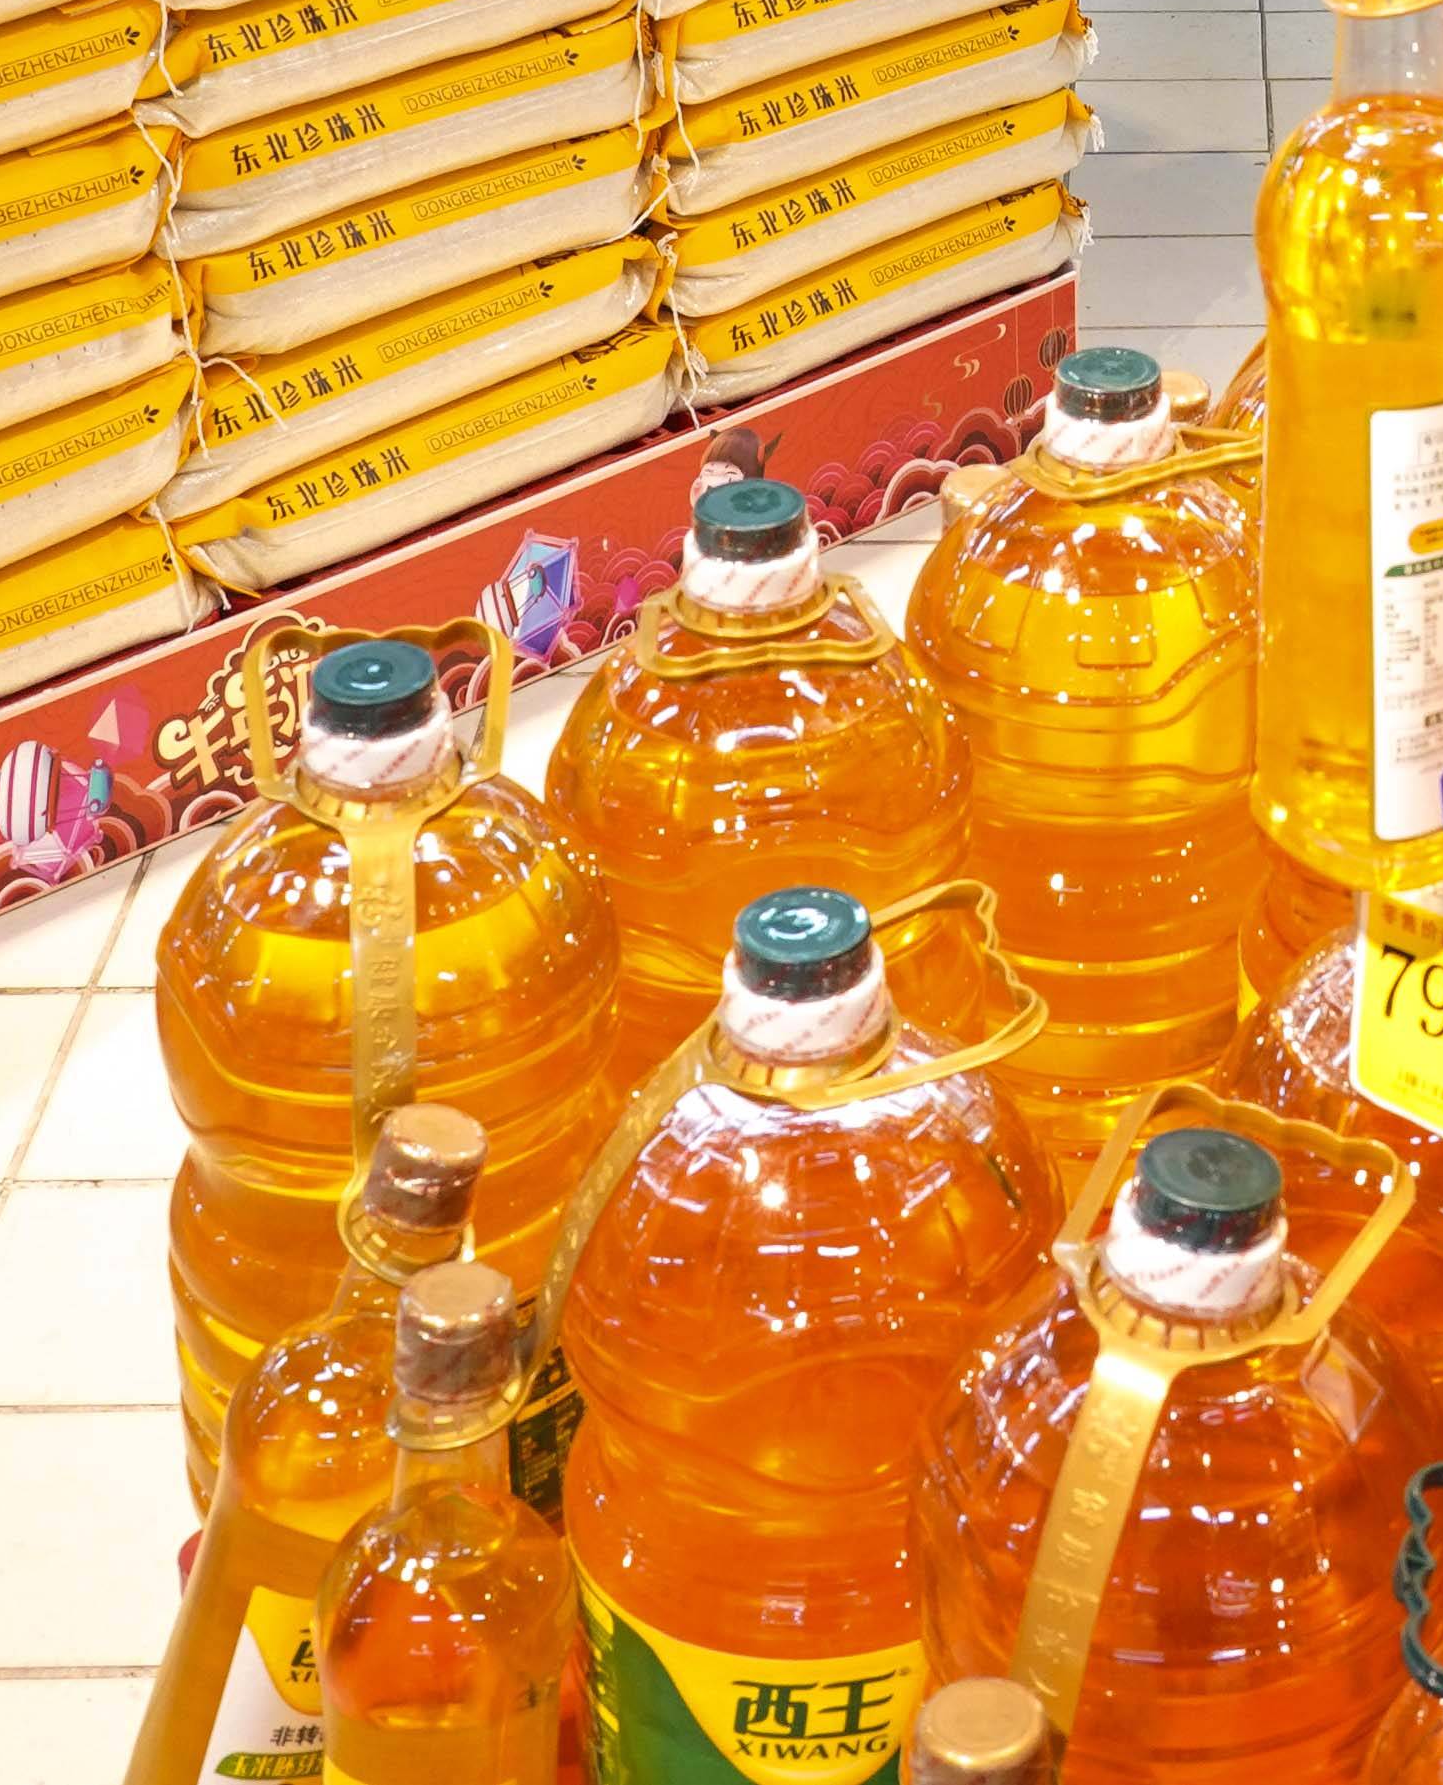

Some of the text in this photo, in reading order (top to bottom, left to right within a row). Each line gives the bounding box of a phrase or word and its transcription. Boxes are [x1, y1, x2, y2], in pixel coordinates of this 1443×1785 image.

[730, 180, 856, 249] 东北珍珠米
[268, 448, 410, 522] 东北珍珠米
[734, 1672, 896, 1740] 西王
[734, 1736, 889, 1759] XIWANG
